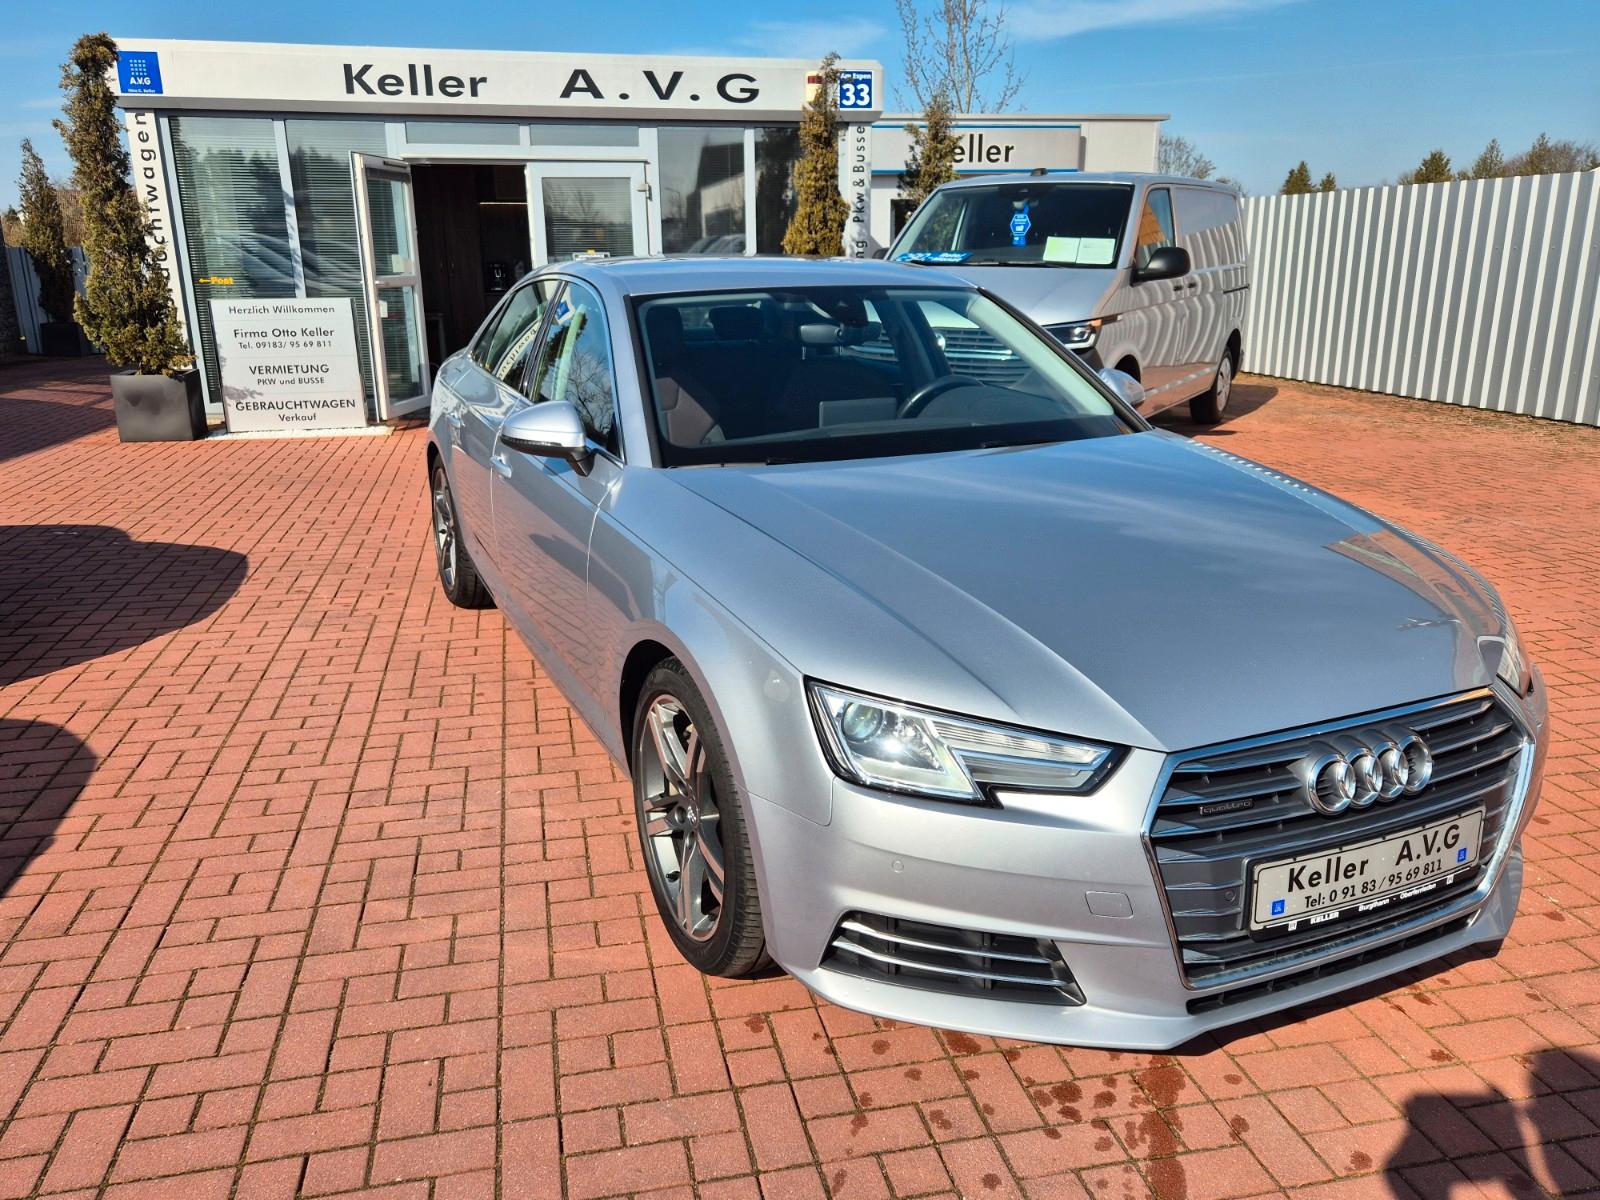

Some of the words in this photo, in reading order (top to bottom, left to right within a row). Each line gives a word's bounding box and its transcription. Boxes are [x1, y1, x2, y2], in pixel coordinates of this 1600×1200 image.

[130, 76, 151, 85] A.V.G
[342, 64, 488, 98] Keller
[560, 69, 760, 104] A.V.G
[841, 83, 870, 106] 33
[852, 126, 866, 173] Busse
[953, 133, 1015, 164] eller
[852, 179, 865, 188] &
[852, 192, 865, 223] Pkw
[211, 276, 234, 285] Post
[228, 306, 270, 315] Herzlich
[272, 305, 335, 314] Willkommen
[233, 328, 268, 339] Firma
[271, 328, 297, 338] Otto
[301, 327, 335, 338] Keller
[238, 341, 253, 350] Tel.
[255, 341, 287, 350] 09183/
[316, 340, 332, 348] 811
[248, 364, 330, 376] VERMIETUNG
[257, 378, 277, 386] PKW
[279, 377, 296, 385] und
[297, 376, 325, 385] BUSSE
[235, 399, 356, 412] GEBRAUCHTWAGEN
[278, 412, 317, 422] Verkauf
[1287, 856, 1369, 893] Keller
[1394, 823, 1461, 866] A.V.G
[1304, 892, 1326, 909] Tel:
[1329, 889, 1338, 903] 0
[1341, 884, 1356, 899] 91
[1361, 879, 1376, 894] 83
[1378, 876, 1387, 890] /
[1388, 872, 1402, 887] 95
[1405, 866, 1420, 881] 69
[1423, 859, 1442, 875] 811
[1310, 911, 1340, 924] KELLER
